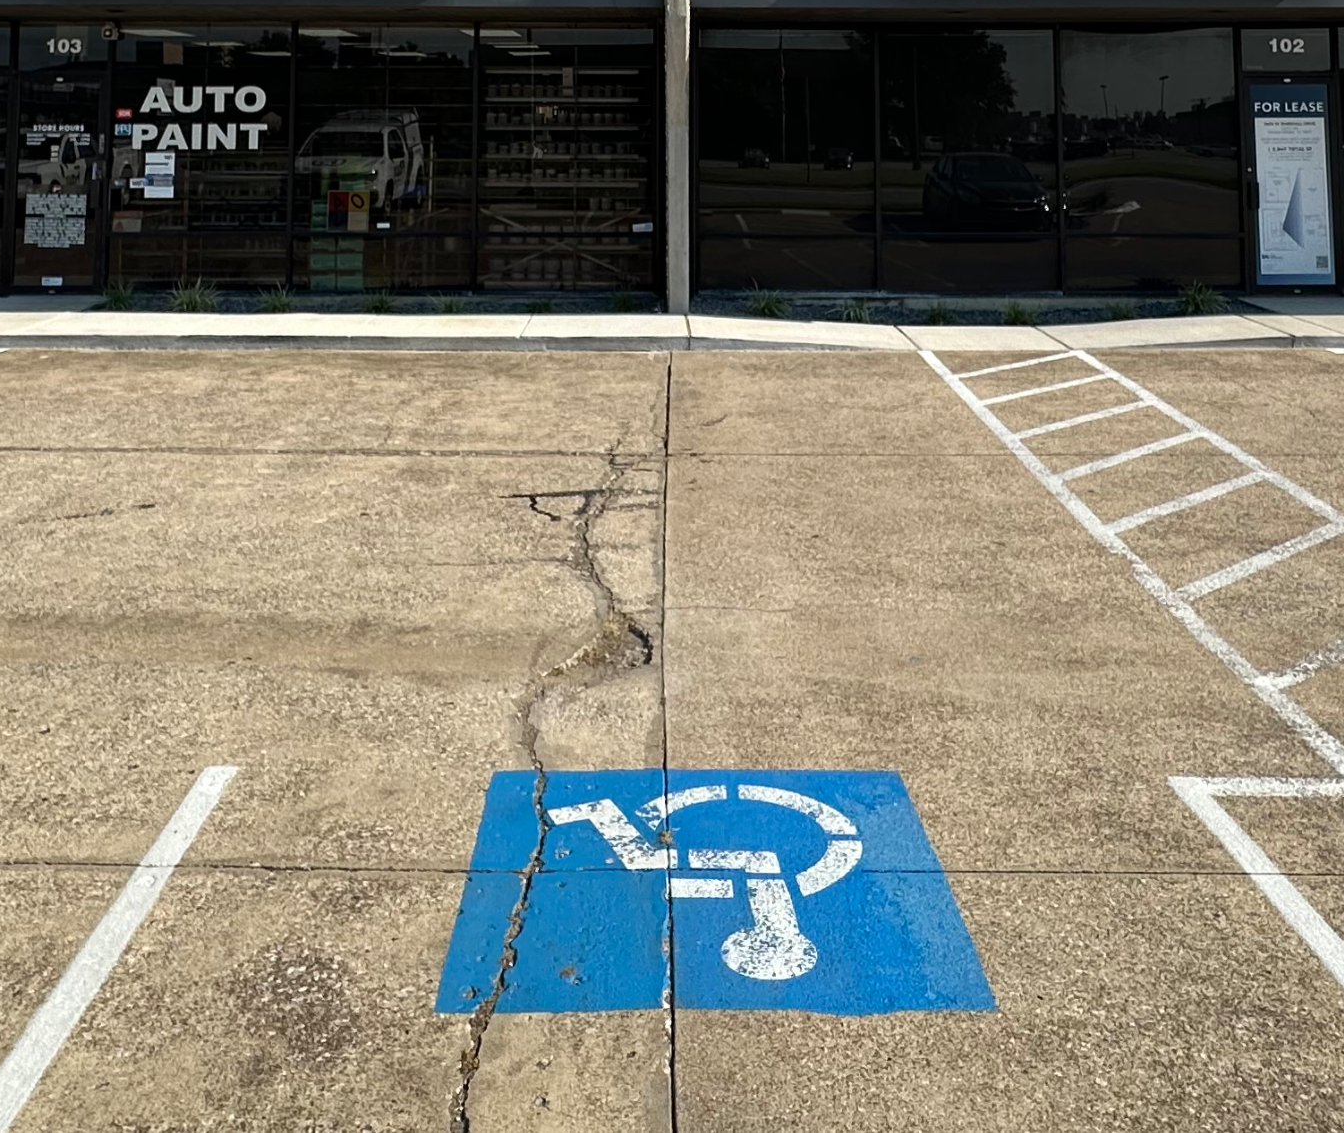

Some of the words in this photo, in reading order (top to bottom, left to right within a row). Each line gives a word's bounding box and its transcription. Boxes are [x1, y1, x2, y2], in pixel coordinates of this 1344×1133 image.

[47, 38, 82, 54] 103
[1269, 38, 1305, 53] 102
[139, 85, 267, 113] AUTO
[1254, 101, 1281, 113] FOR
[1284, 101, 1324, 113] LEASE
[33, 124, 57, 132] STORE
[59, 124, 85, 132] HOURS
[131, 122, 269, 150] PAINT
